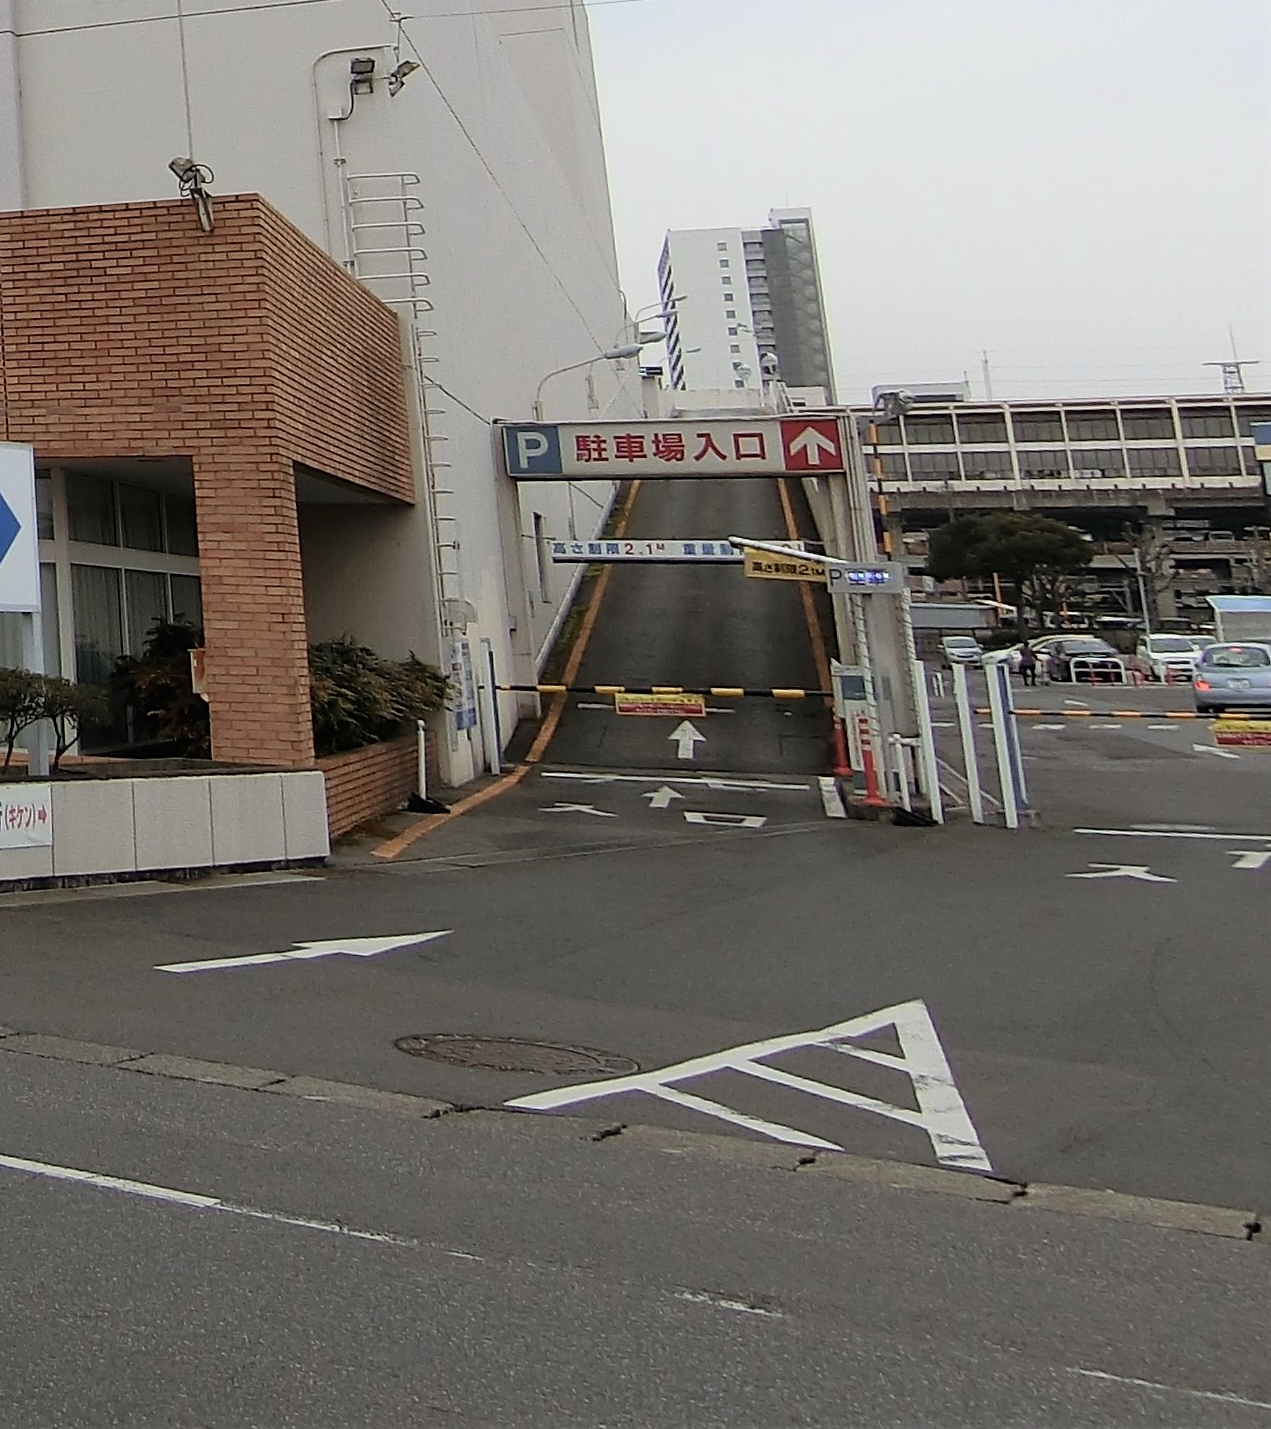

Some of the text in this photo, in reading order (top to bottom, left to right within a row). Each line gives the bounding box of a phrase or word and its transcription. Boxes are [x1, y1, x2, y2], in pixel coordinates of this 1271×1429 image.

[517, 431, 548, 469] P
[574, 432, 767, 464] 駐車場入口
